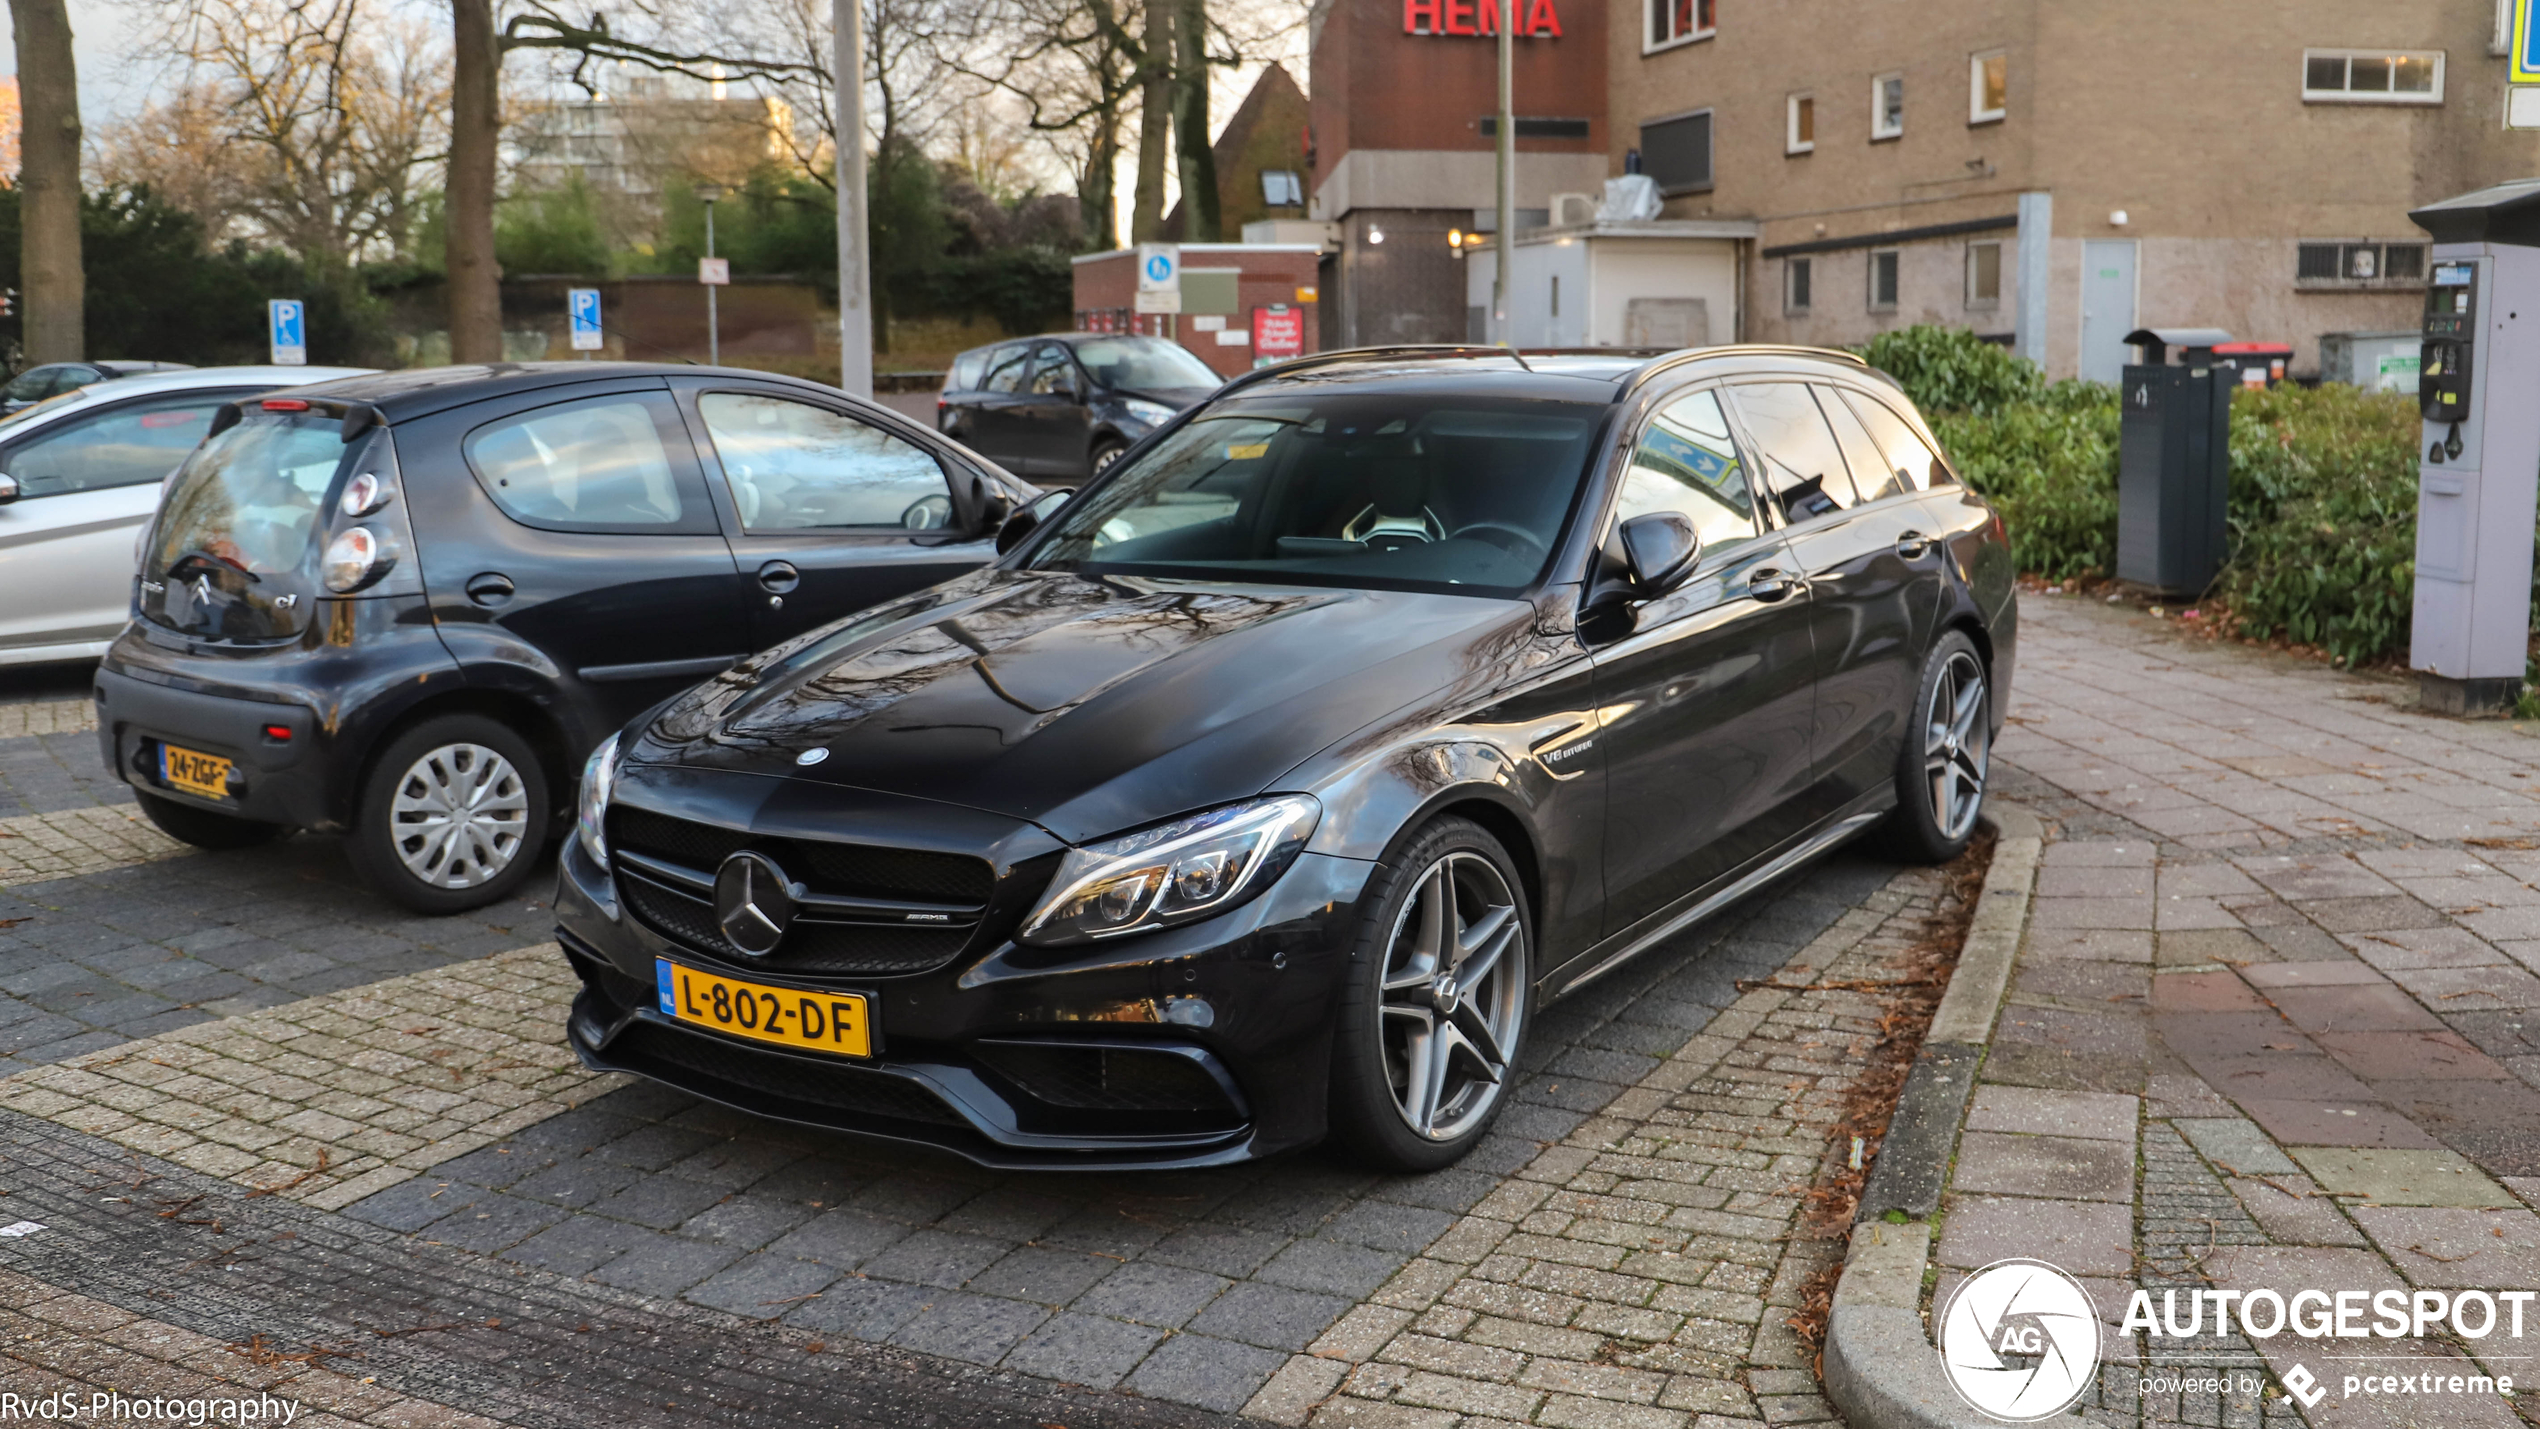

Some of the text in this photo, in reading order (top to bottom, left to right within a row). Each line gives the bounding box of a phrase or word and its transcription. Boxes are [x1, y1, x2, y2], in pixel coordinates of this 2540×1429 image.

[1404, 0, 1562, 36] HEMA
[577, 293, 594, 316] P
[277, 305, 297, 328] P
[661, 992, 674, 1007] NL
[683, 974, 852, 1043] L-802-DF
